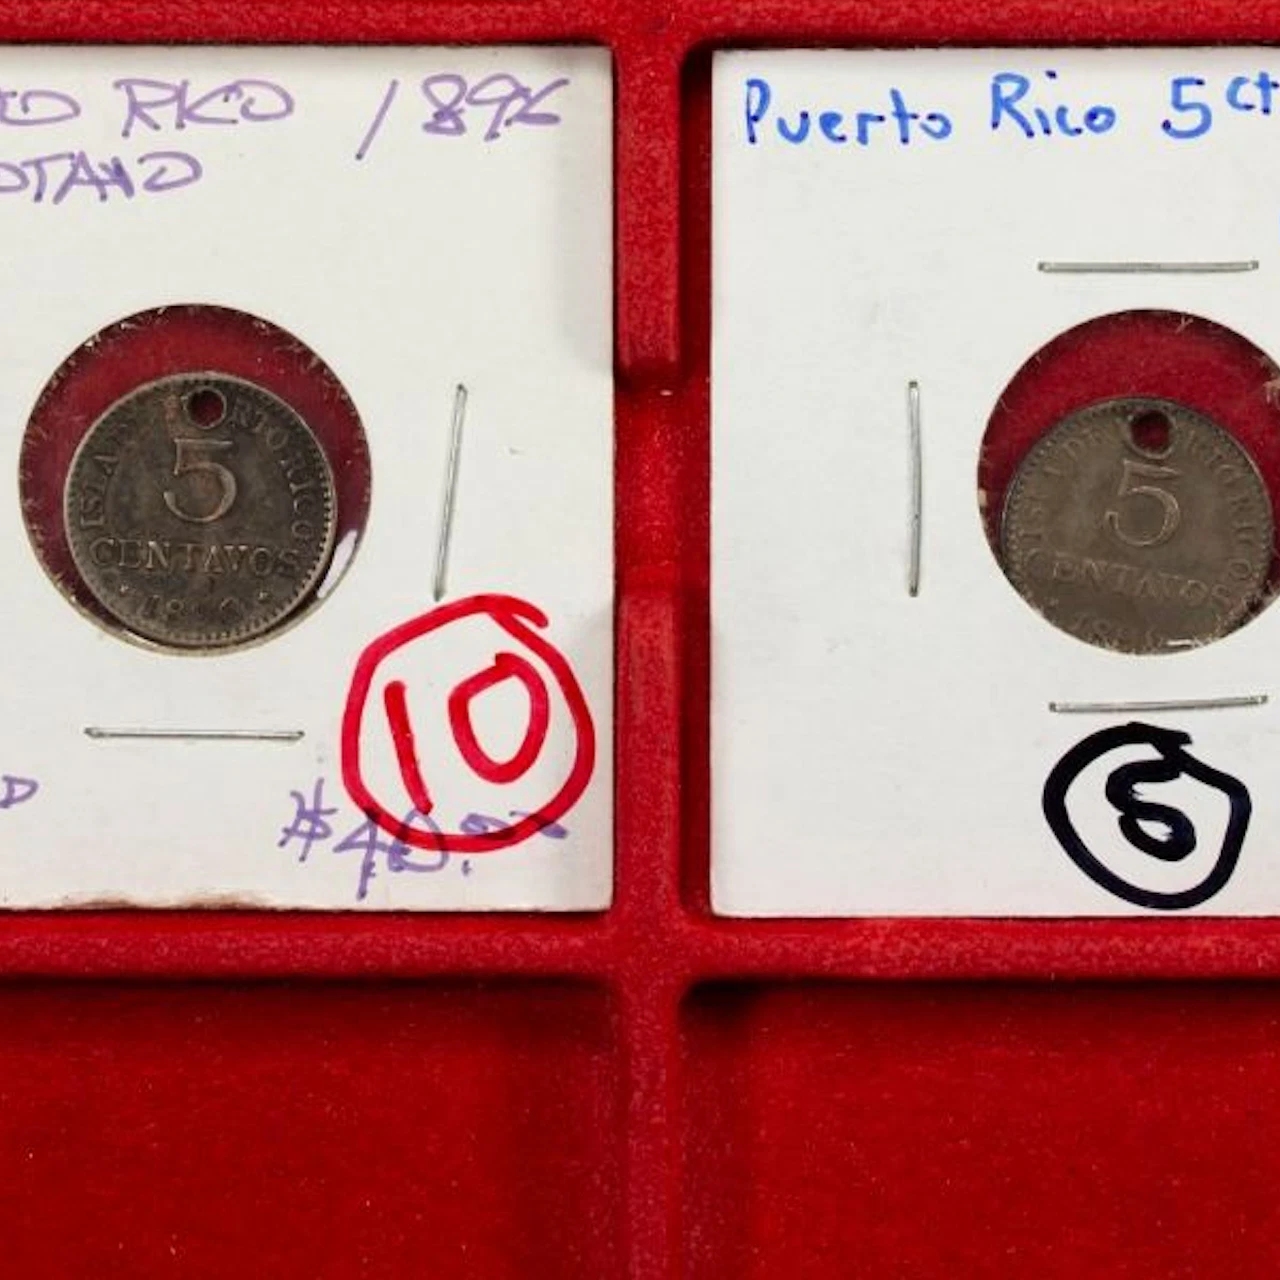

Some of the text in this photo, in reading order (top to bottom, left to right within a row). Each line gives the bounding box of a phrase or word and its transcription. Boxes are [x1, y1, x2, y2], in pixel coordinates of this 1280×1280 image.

[744, 78, 953, 145] Puerto
[990, 69, 1117, 140] Rico
[162, 437, 238, 523] 5
[1104, 458, 1181, 547] 5
[383, 651, 551, 816] 10
